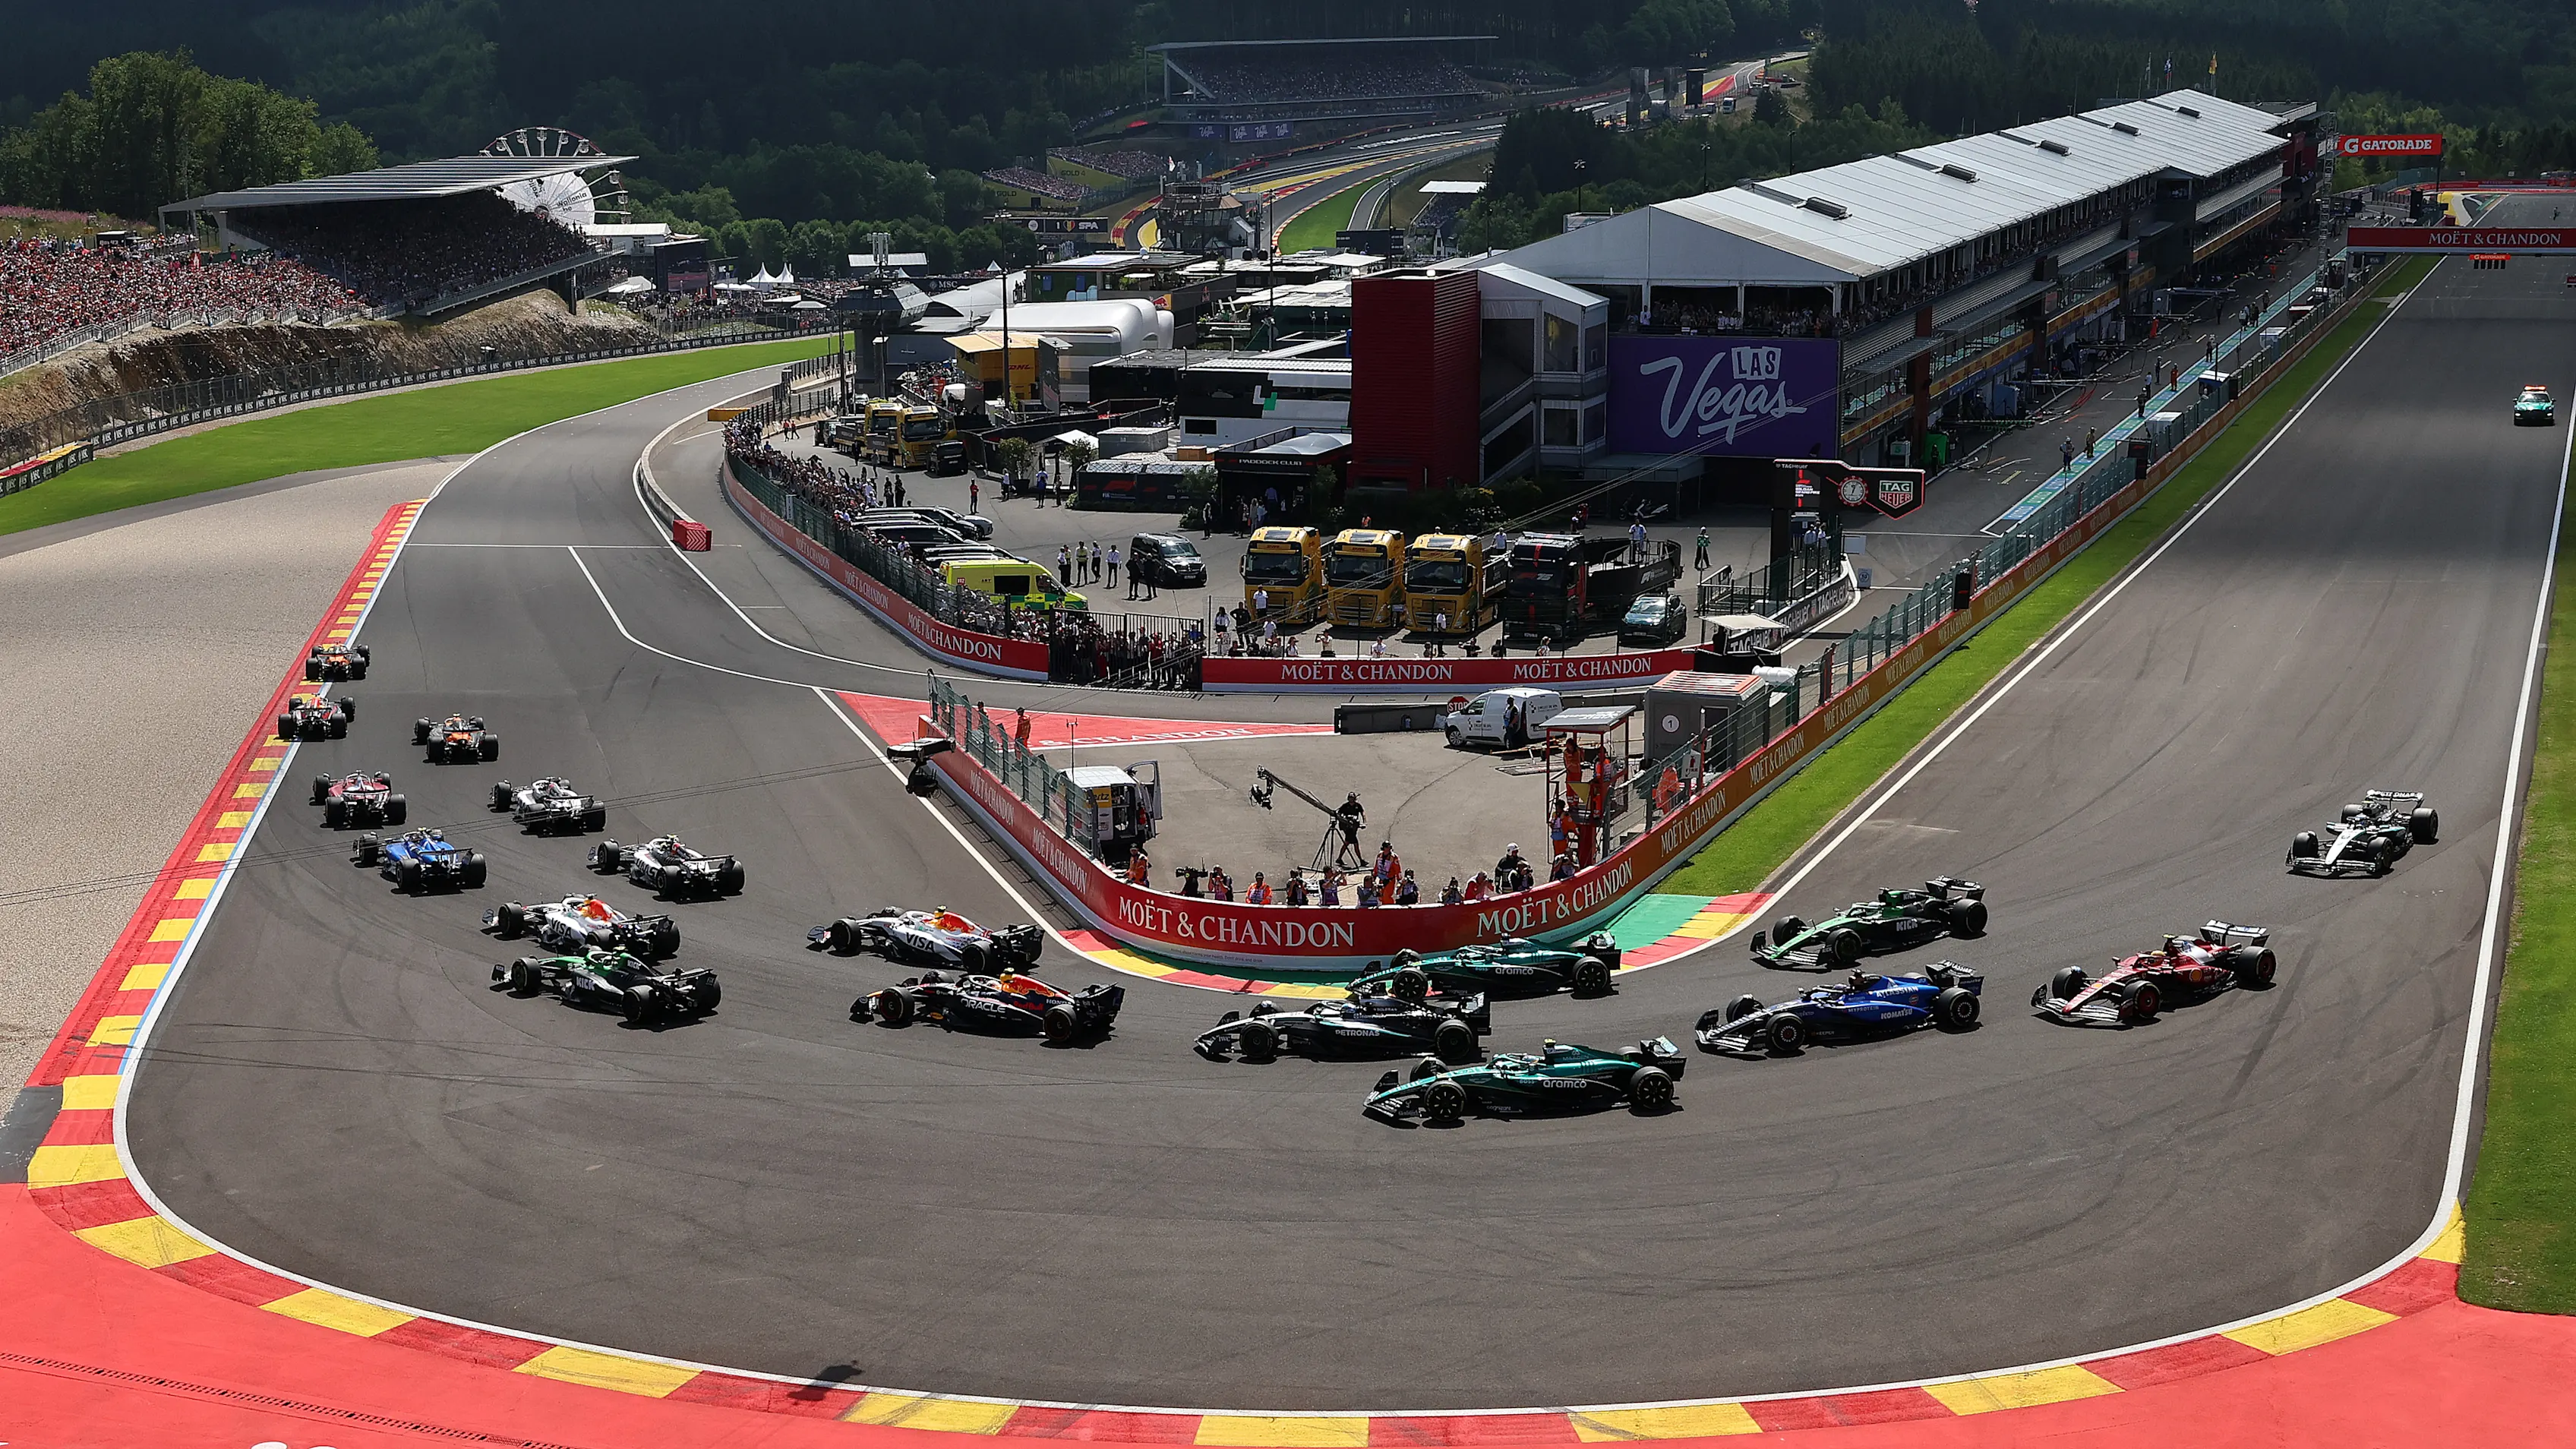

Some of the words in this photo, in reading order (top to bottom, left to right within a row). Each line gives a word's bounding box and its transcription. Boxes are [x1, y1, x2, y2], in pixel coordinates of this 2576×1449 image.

[2362, 140, 2432, 150] GATORADE
[2429, 231, 2471, 245] MOËT
[2474, 233, 2484, 245] &
[2486, 233, 2561, 245] CHANDON
[1735, 349, 1779, 377] LAS
[1883, 483, 1910, 492] TAG
[1880, 494, 1910, 507] HEUER
[863, 582, 889, 609] CHANDON
[908, 612, 925, 636] MOËT
[925, 625, 930, 639] &
[930, 629, 1002, 660] CHANDON
[1282, 660, 1337, 680] MOËT
[1342, 665, 1353, 680] &
[1357, 665, 1452, 680] CHANDON
[1514, 659, 1561, 680] MOËT
[1566, 662, 1576, 678] &
[1580, 657, 1651, 677] CHANDON
[1668, 720, 1672, 728] 1
[1071, 728, 1255, 745] CHANDON
[1750, 753, 1769, 788] MOËT
[1769, 756, 1774, 773] &
[1774, 731, 1805, 769] CHANDON
[970, 770, 985, 798] MOËT
[984, 783, 989, 803] &
[989, 785, 1015, 827] CHANDON
[1661, 819, 1684, 857] MOËT
[1683, 819, 1690, 840] &
[1690, 788, 1727, 835] CHANDON
[1032, 827, 1050, 860] MOËT
[1050, 845, 1055, 866] &
[1054, 848, 1087, 895] CHANDON
[1477, 896, 1551, 938] MOËT
[1556, 893, 1570, 920] &
[1572, 857, 1633, 913] CHANDON
[551, 918, 571, 938] VISA
[1119, 896, 1172, 934] MOËT
[1178, 912, 1195, 939] &
[1200, 915, 1355, 948] CHANDON
[1896, 920, 1917, 931] KICK
[905, 932, 934, 953] VISA
[576, 976, 595, 991] KICK
[1876, 986, 1919, 998] ATLASSIAN
[961, 998, 1006, 1013] ORACLE
[1881, 1009, 1913, 1019] KOMATSU
[1543, 1079, 1587, 1089] aramco
